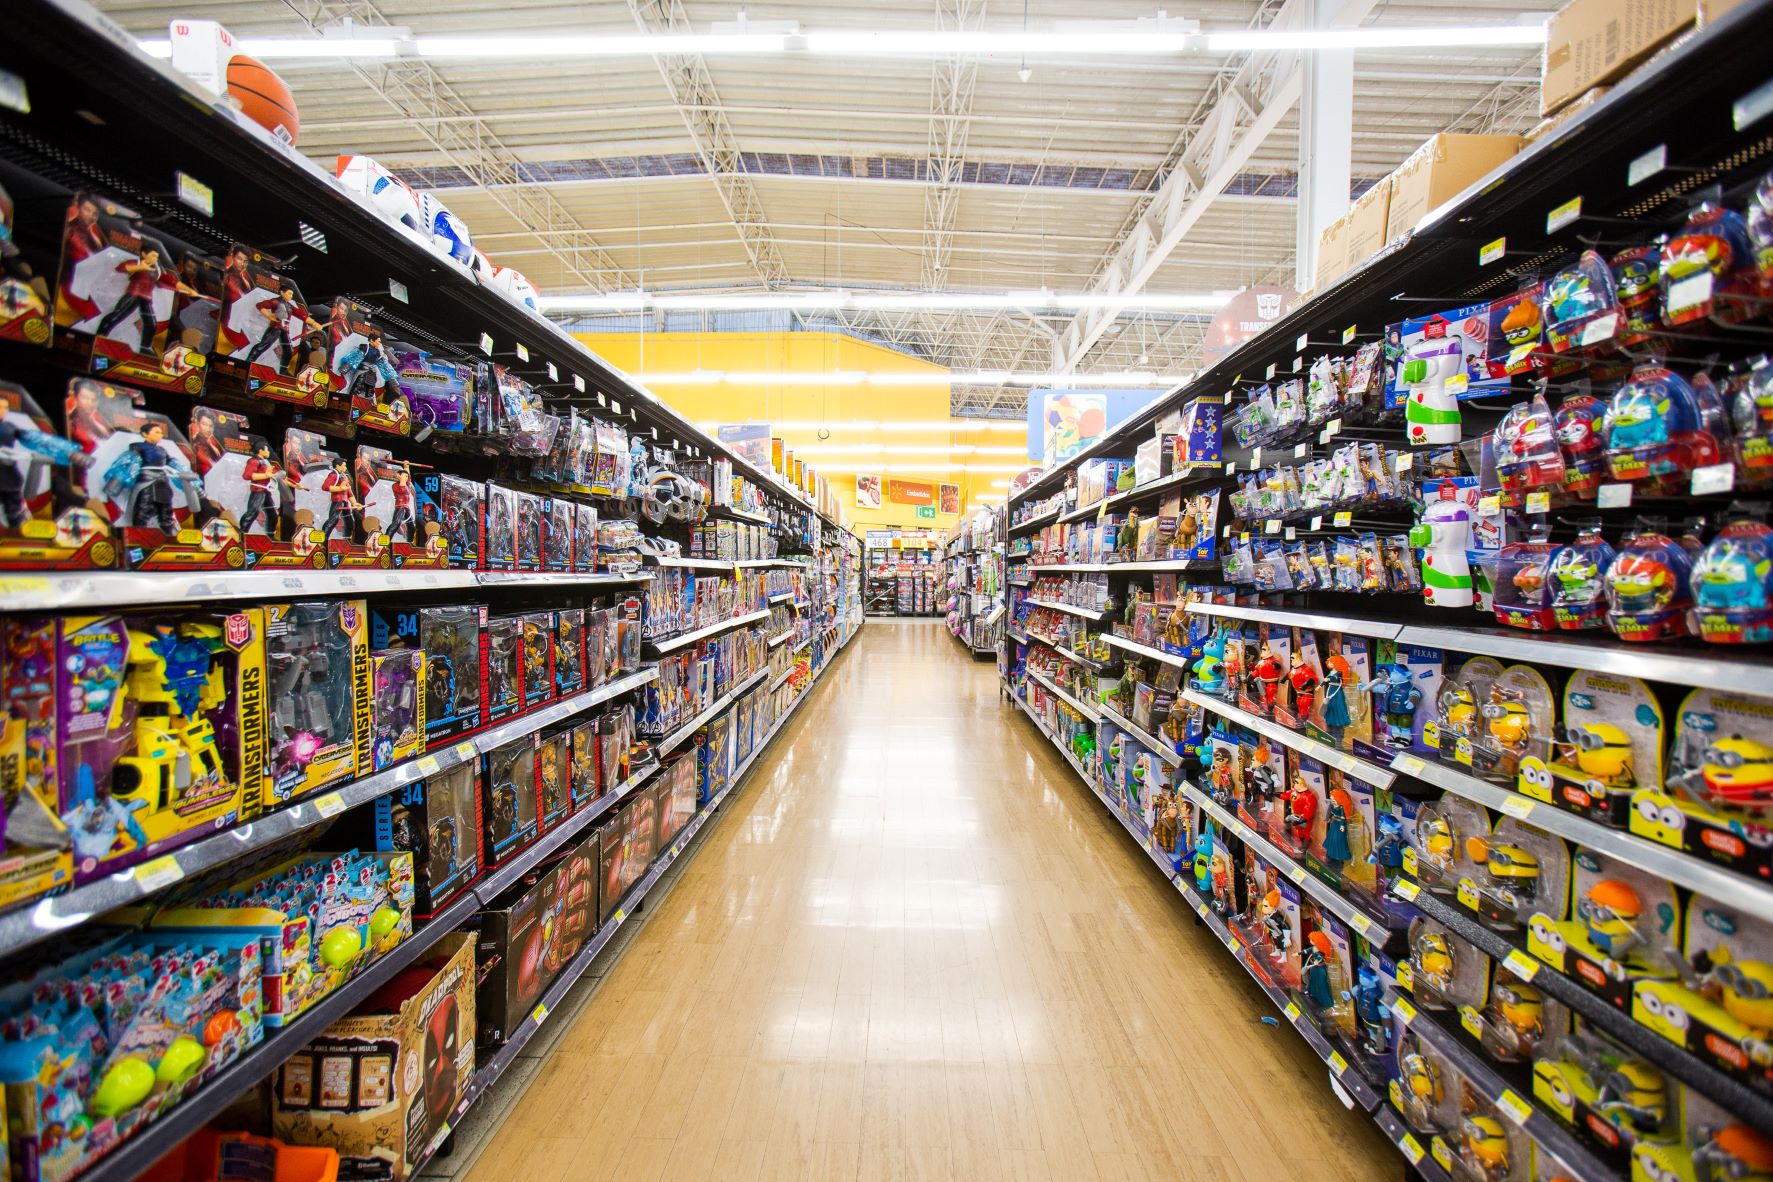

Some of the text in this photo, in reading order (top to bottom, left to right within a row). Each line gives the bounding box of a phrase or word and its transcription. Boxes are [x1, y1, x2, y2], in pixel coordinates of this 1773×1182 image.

[1552, 334, 1567, 344] MIX
[1505, 361, 1527, 373] REMIX
[425, 477, 439, 493] 59
[1196, 549, 1208, 557] TOY
[269, 608, 280, 623] 2
[1509, 616, 1529, 625] REMIX
[397, 614, 418, 637] 34
[1615, 624, 1649, 634] REMIX
[1701, 624, 1740, 634] REMIX
[73, 633, 121, 647] BATTLE
[1413, 648, 1439, 659] PIXAR
[479, 633, 489, 722] TRANSFORMERS
[354, 643, 368, 775] TRANSFORMERS
[417, 679, 425, 753] TRANSFORMERS
[430, 728, 452, 739] MEGATRON
[241, 667, 260, 816] TRANSFORMERS
[1183, 743, 1195, 751] TOY
[313, 744, 354, 763] CYBERVERSE
[401, 783, 424, 806] 34
[326, 874, 336, 885] 2
[193, 960, 205, 975] 2
[109, 983, 124, 1001] 2
[418, 965, 465, 1026] DEADPOOL
